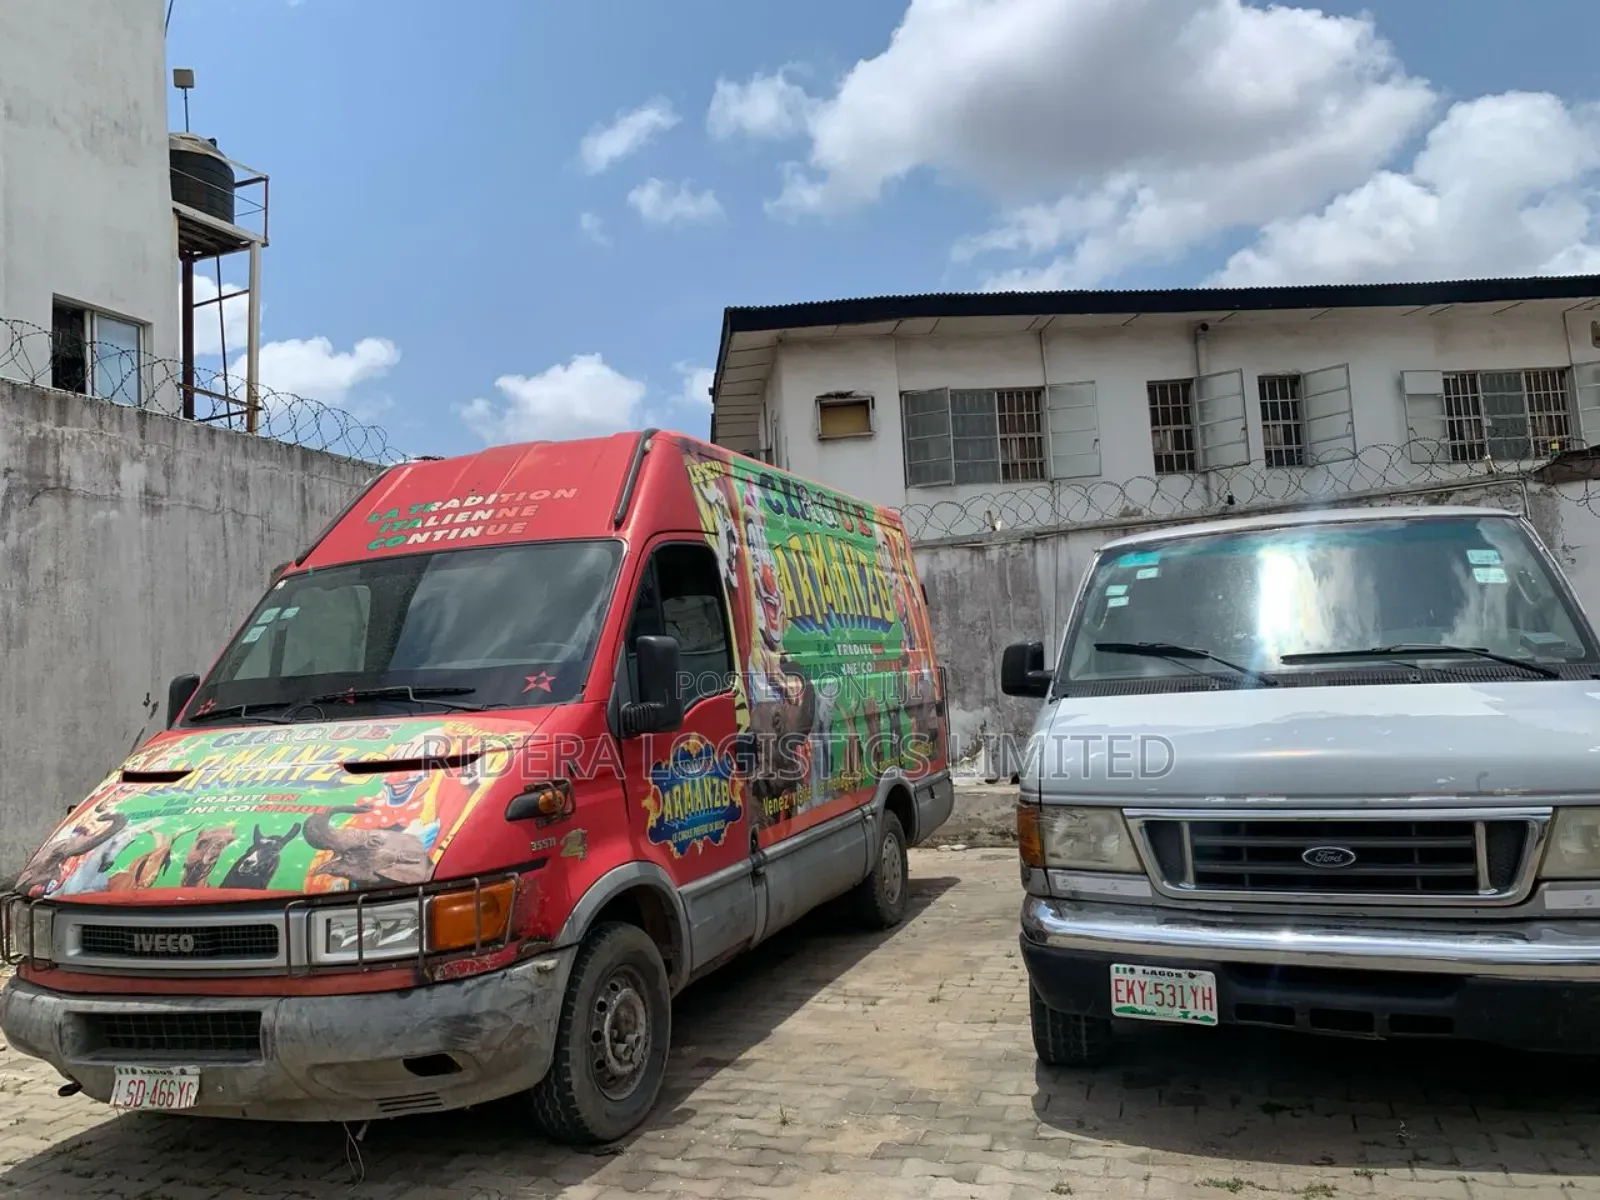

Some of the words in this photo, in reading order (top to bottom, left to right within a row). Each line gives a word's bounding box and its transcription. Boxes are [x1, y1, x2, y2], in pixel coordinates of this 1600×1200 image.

[367, 507, 400, 524] LA
[408, 487, 579, 514] TRADITION
[378, 504, 539, 533] ITALIENNE
[758, 471, 873, 538] CIRQUE
[366, 521, 529, 551] CONTINUE
[210, 722, 401, 749] CIRQUE
[663, 776, 730, 821] ARMANZO
[1315, 850, 1343, 862] Ford
[133, 933, 196, 953] IVECO
[1141, 968, 1183, 979] LAGOS
